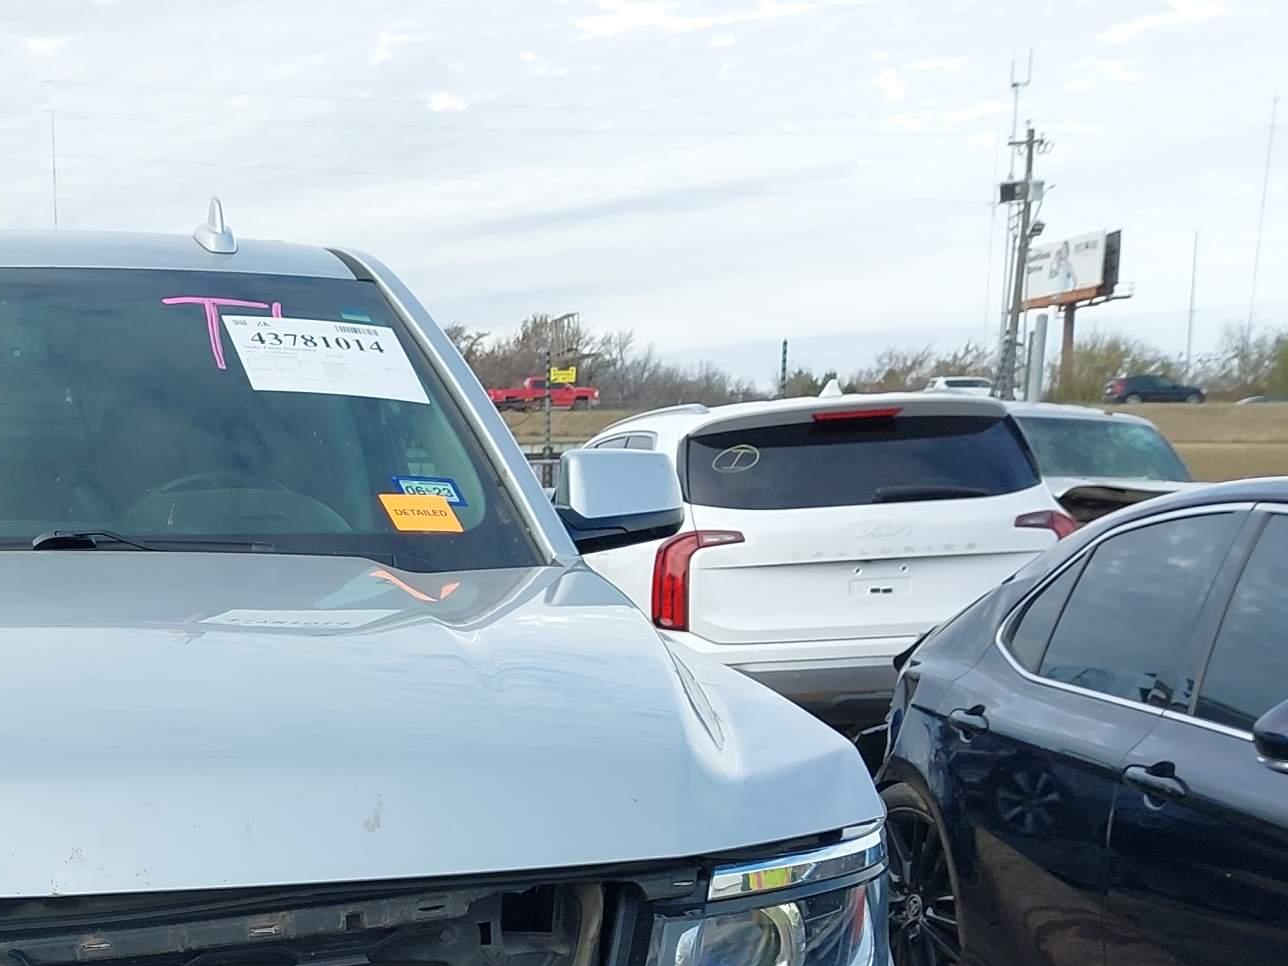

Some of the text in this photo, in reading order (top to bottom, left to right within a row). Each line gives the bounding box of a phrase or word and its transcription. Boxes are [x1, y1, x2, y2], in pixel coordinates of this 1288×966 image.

[250, 331, 385, 354] 43781014
[405, 485, 426, 496] 06
[393, 508, 448, 518] DETAILED
